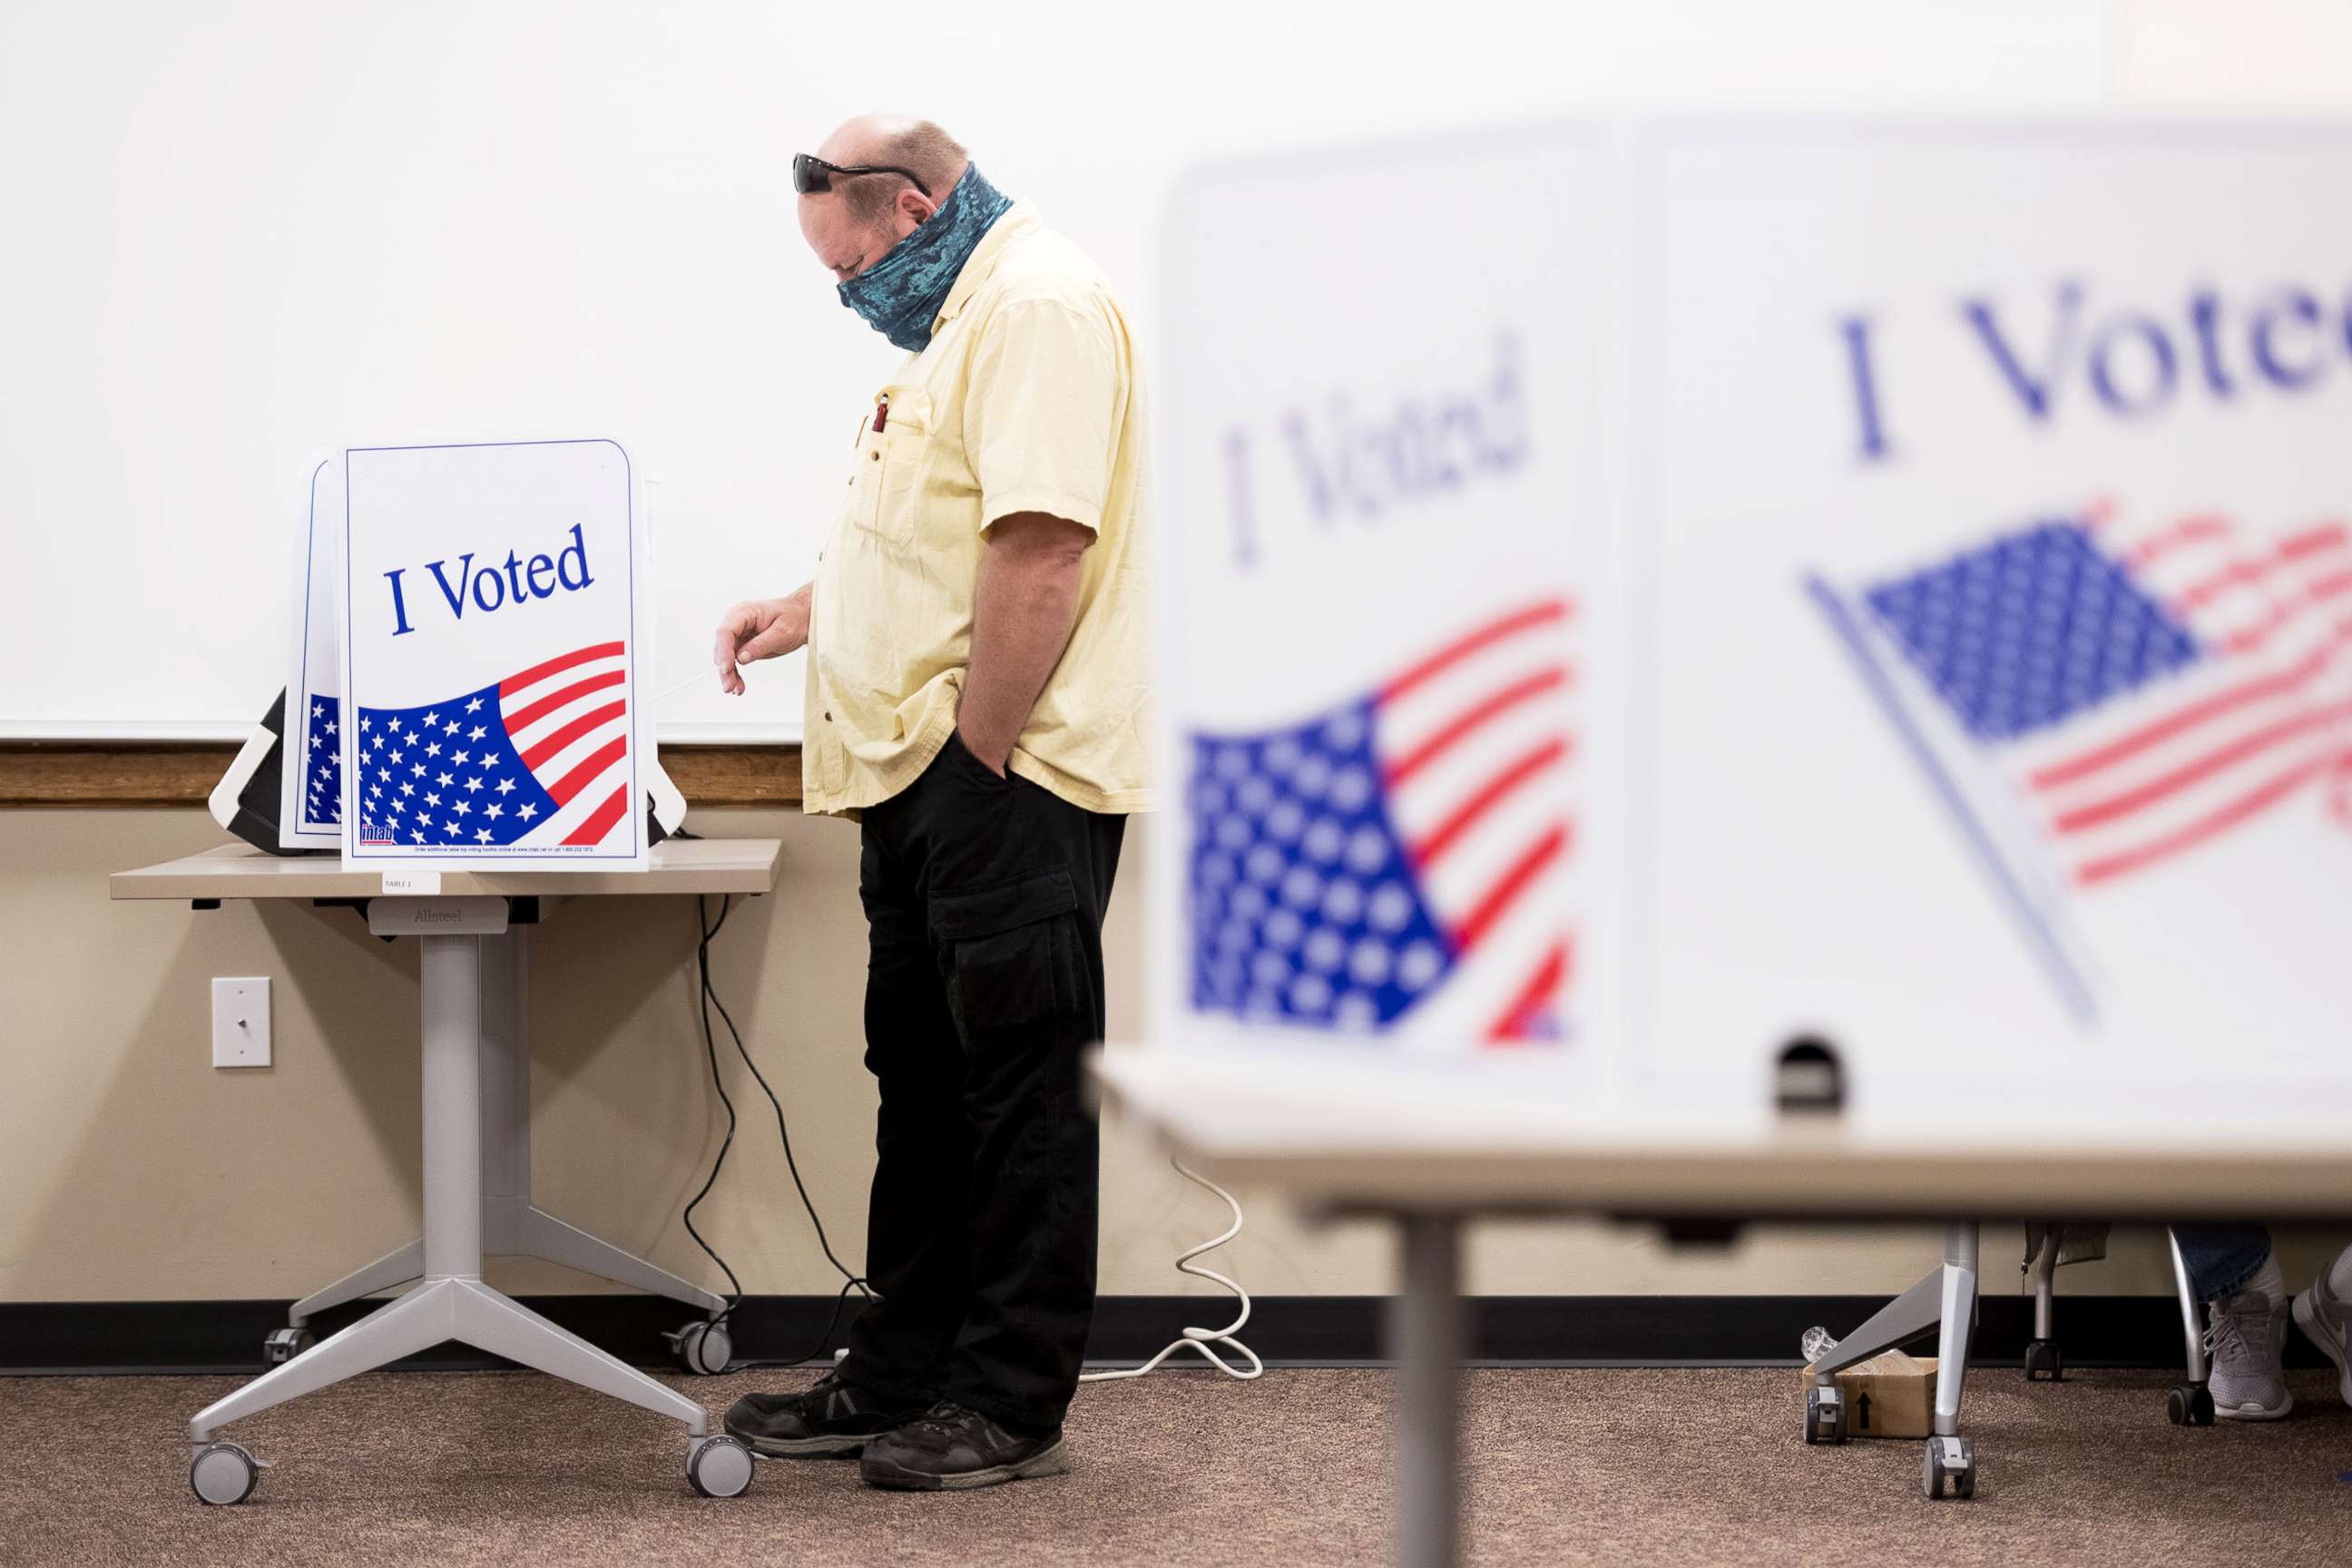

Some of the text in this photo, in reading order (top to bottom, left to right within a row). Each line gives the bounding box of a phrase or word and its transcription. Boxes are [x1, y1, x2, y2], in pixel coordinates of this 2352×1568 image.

[1837, 270, 2352, 466] I Vote
[384, 522, 595, 636] I Voted
[362, 824, 392, 840] intab
[386, 880, 405, 888] TABLE
[414, 907, 461, 922] Allsteel
